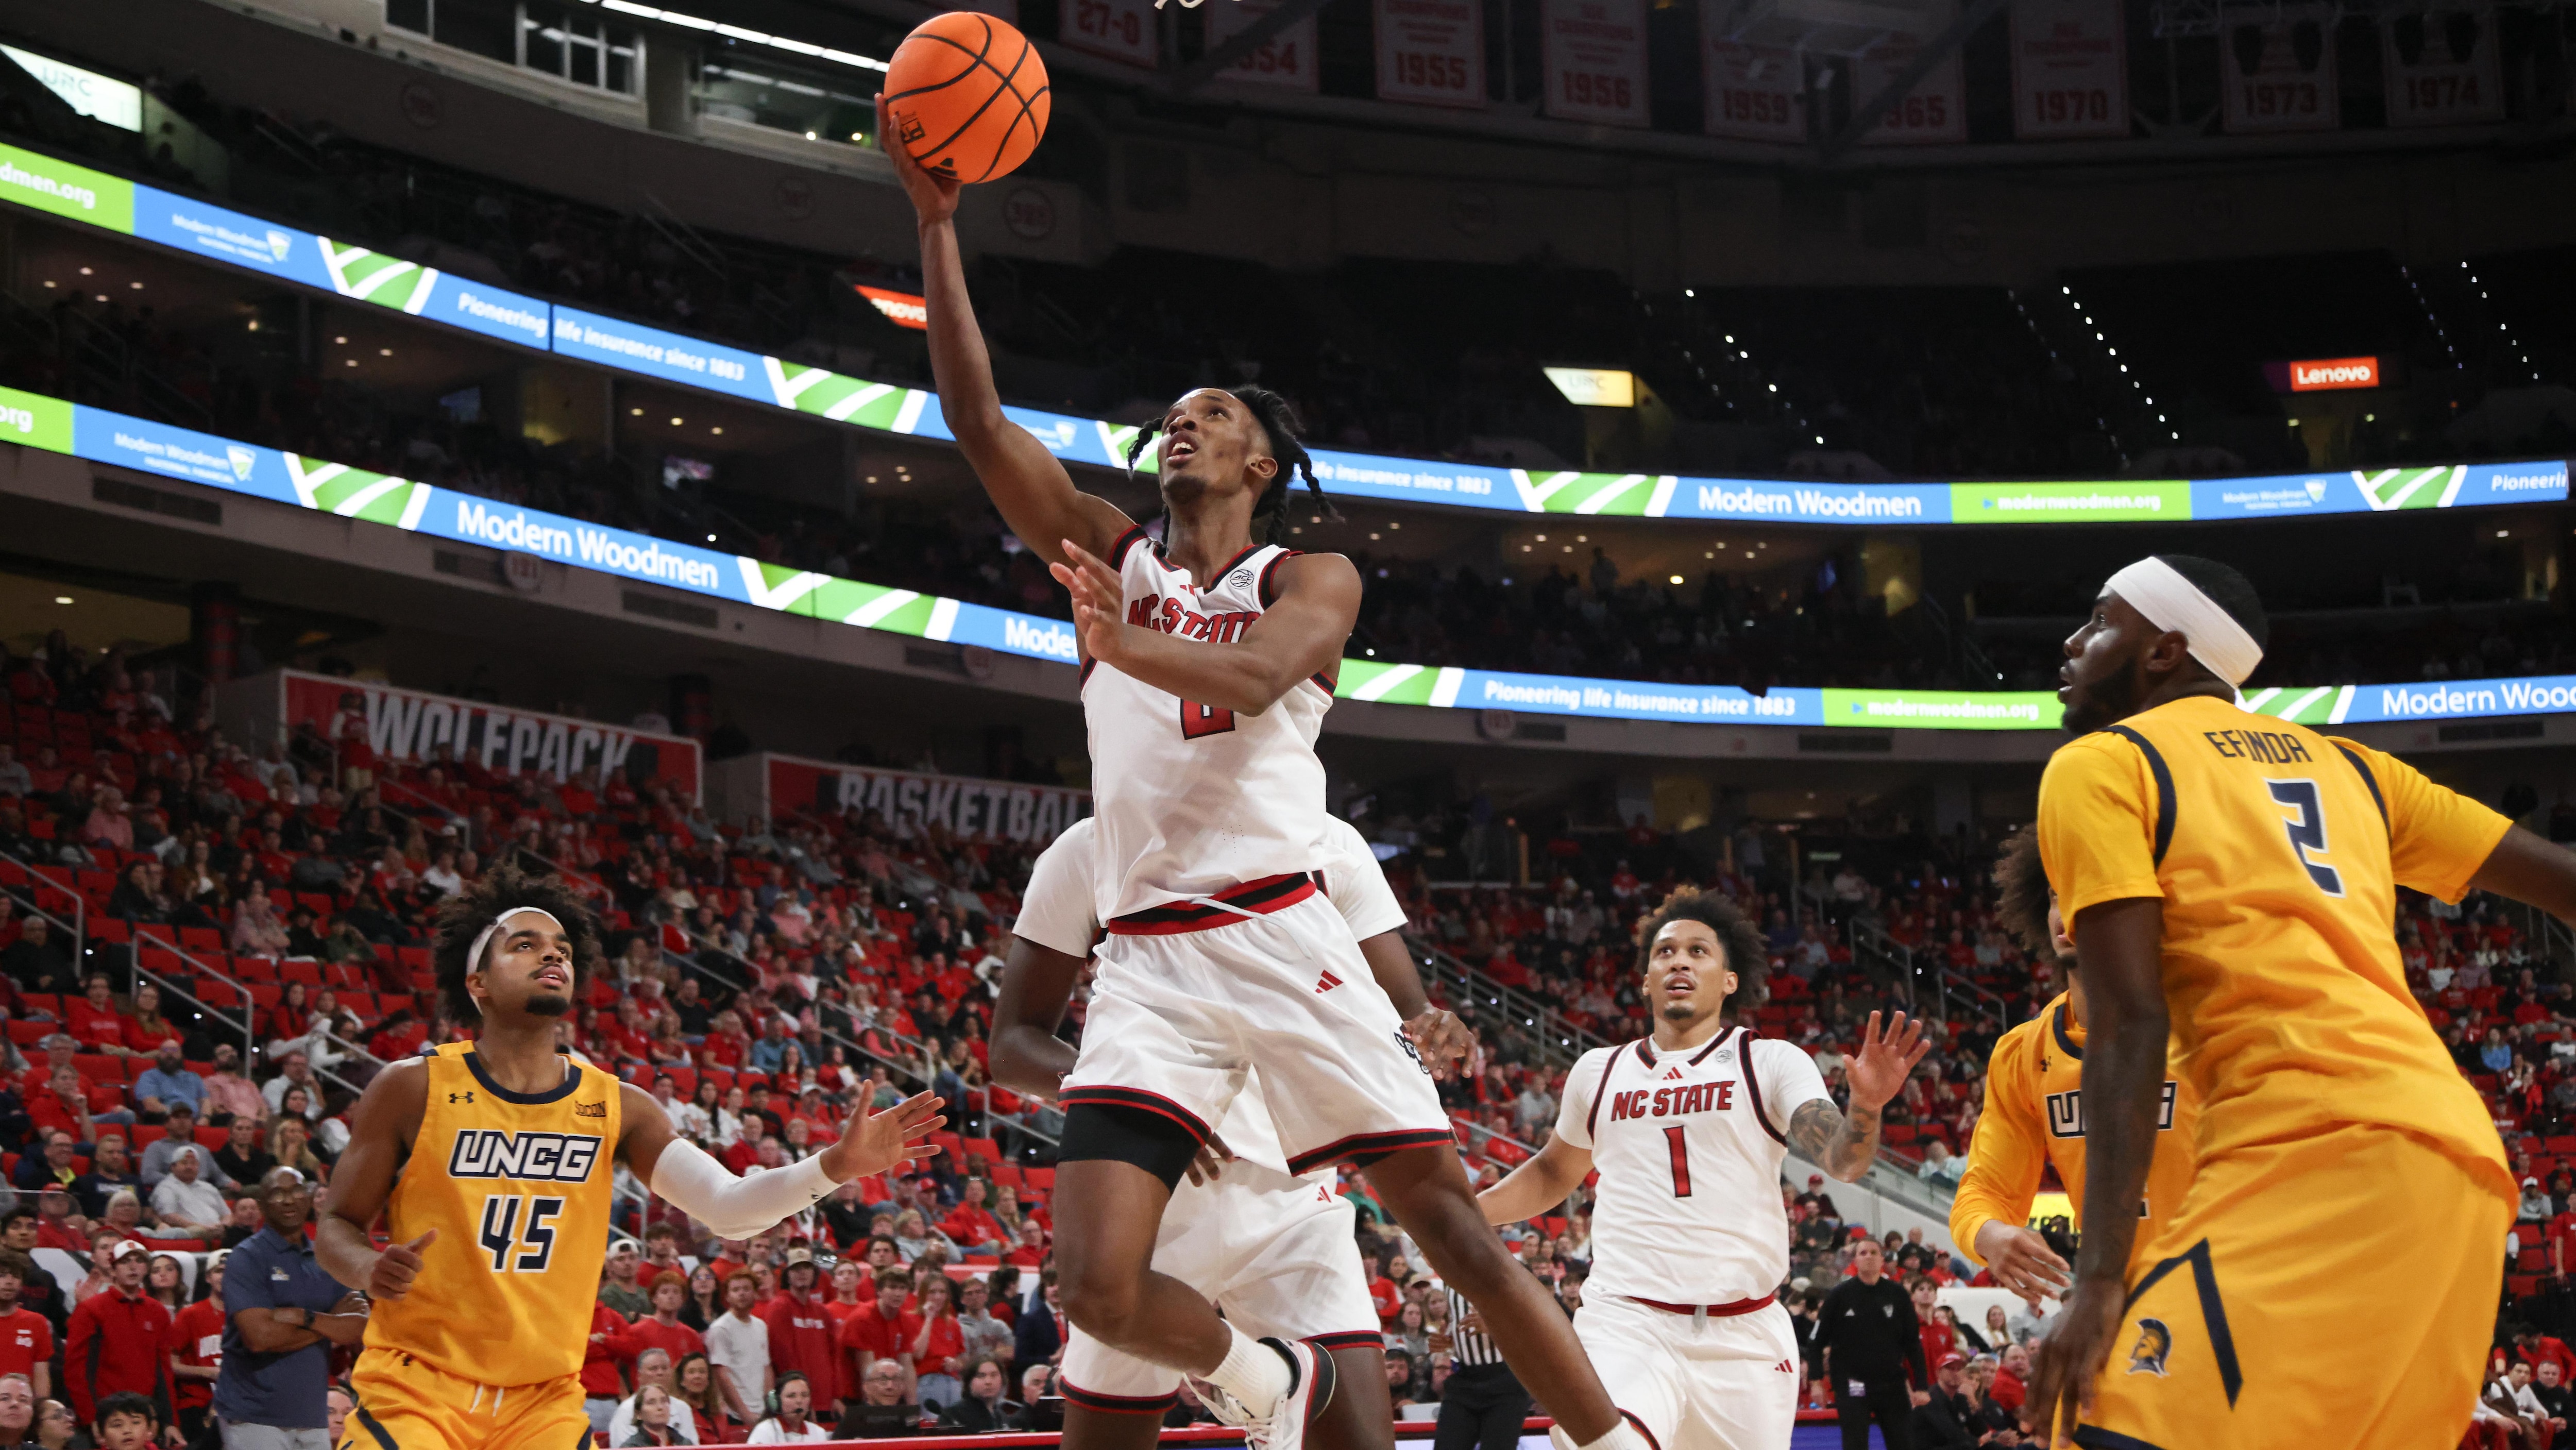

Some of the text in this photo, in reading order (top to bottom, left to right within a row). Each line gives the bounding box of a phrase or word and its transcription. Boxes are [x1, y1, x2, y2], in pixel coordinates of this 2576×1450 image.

[1396, 52, 1466, 89] 1955
[1562, 71, 1631, 109] 1956
[2036, 89, 2108, 122] 1970
[2245, 82, 2317, 115] 1973
[2406, 76, 2480, 109] 1974
[457, 292, 548, 338] Pioneering
[554, 317, 583, 342] life
[583, 327, 664, 362] insurance
[664, 347, 706, 372] since
[2296, 365, 2371, 385] Lenovo
[1335, 464, 1412, 487] insurance
[1413, 472, 1453, 491] since
[1699, 485, 1922, 516] Modern Woodmen
[1997, 493, 2161, 511] modernwoodmen.org
[457, 500, 719, 589] Modern Woodmen
[1484, 680, 1795, 716] Pioneering life insurance since 1883
[1868, 699, 2040, 720] modernwoodmen.org
[2382, 685, 2496, 716] Modern
[364, 691, 635, 786] WOLFPACK
[2204, 730, 2313, 765] EFINDA
[837, 773, 1087, 844] BASKETBAL
[2262, 777, 2346, 899] 2
[1611, 1081, 1736, 1121] NC STATE
[446, 1128, 604, 1183] UNCG
[1663, 1125, 1692, 1198] 1
[478, 1194, 566, 1273] 45
